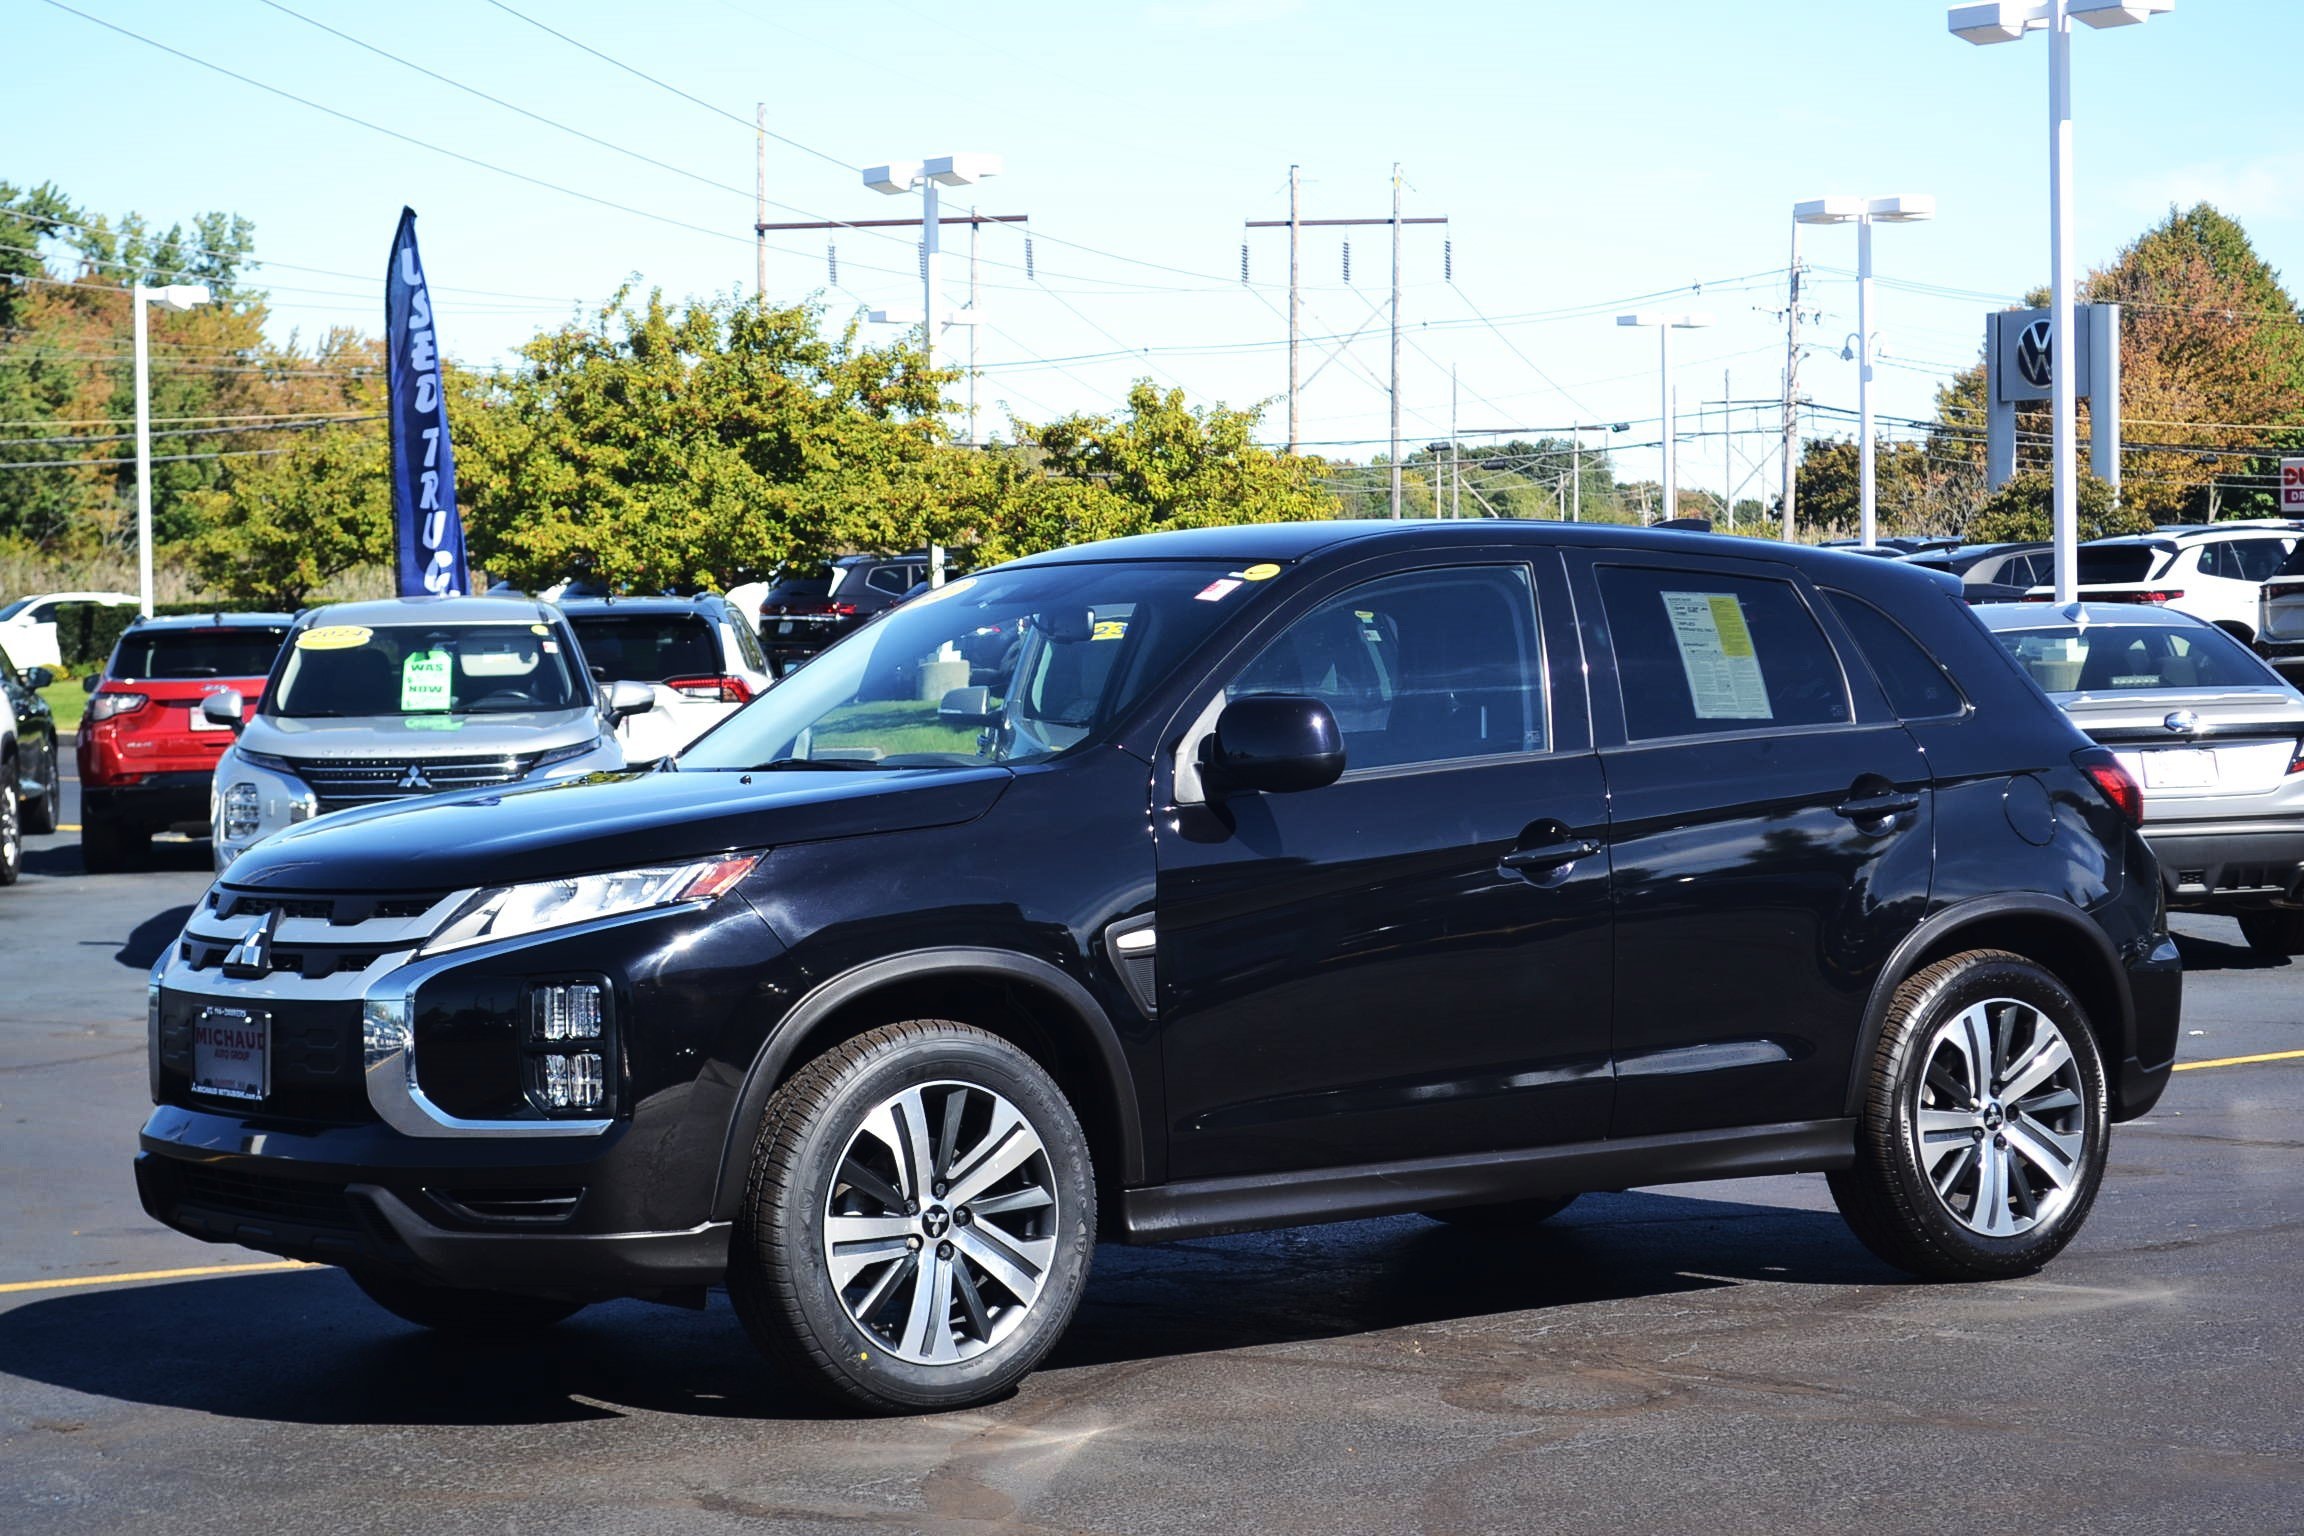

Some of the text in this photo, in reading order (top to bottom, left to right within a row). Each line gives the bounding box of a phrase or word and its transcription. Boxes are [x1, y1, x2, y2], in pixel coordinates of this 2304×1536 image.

[401, 247, 461, 598] USED TRUC
[411, 663, 444, 672] WAS
[408, 685, 443, 693] NOW
